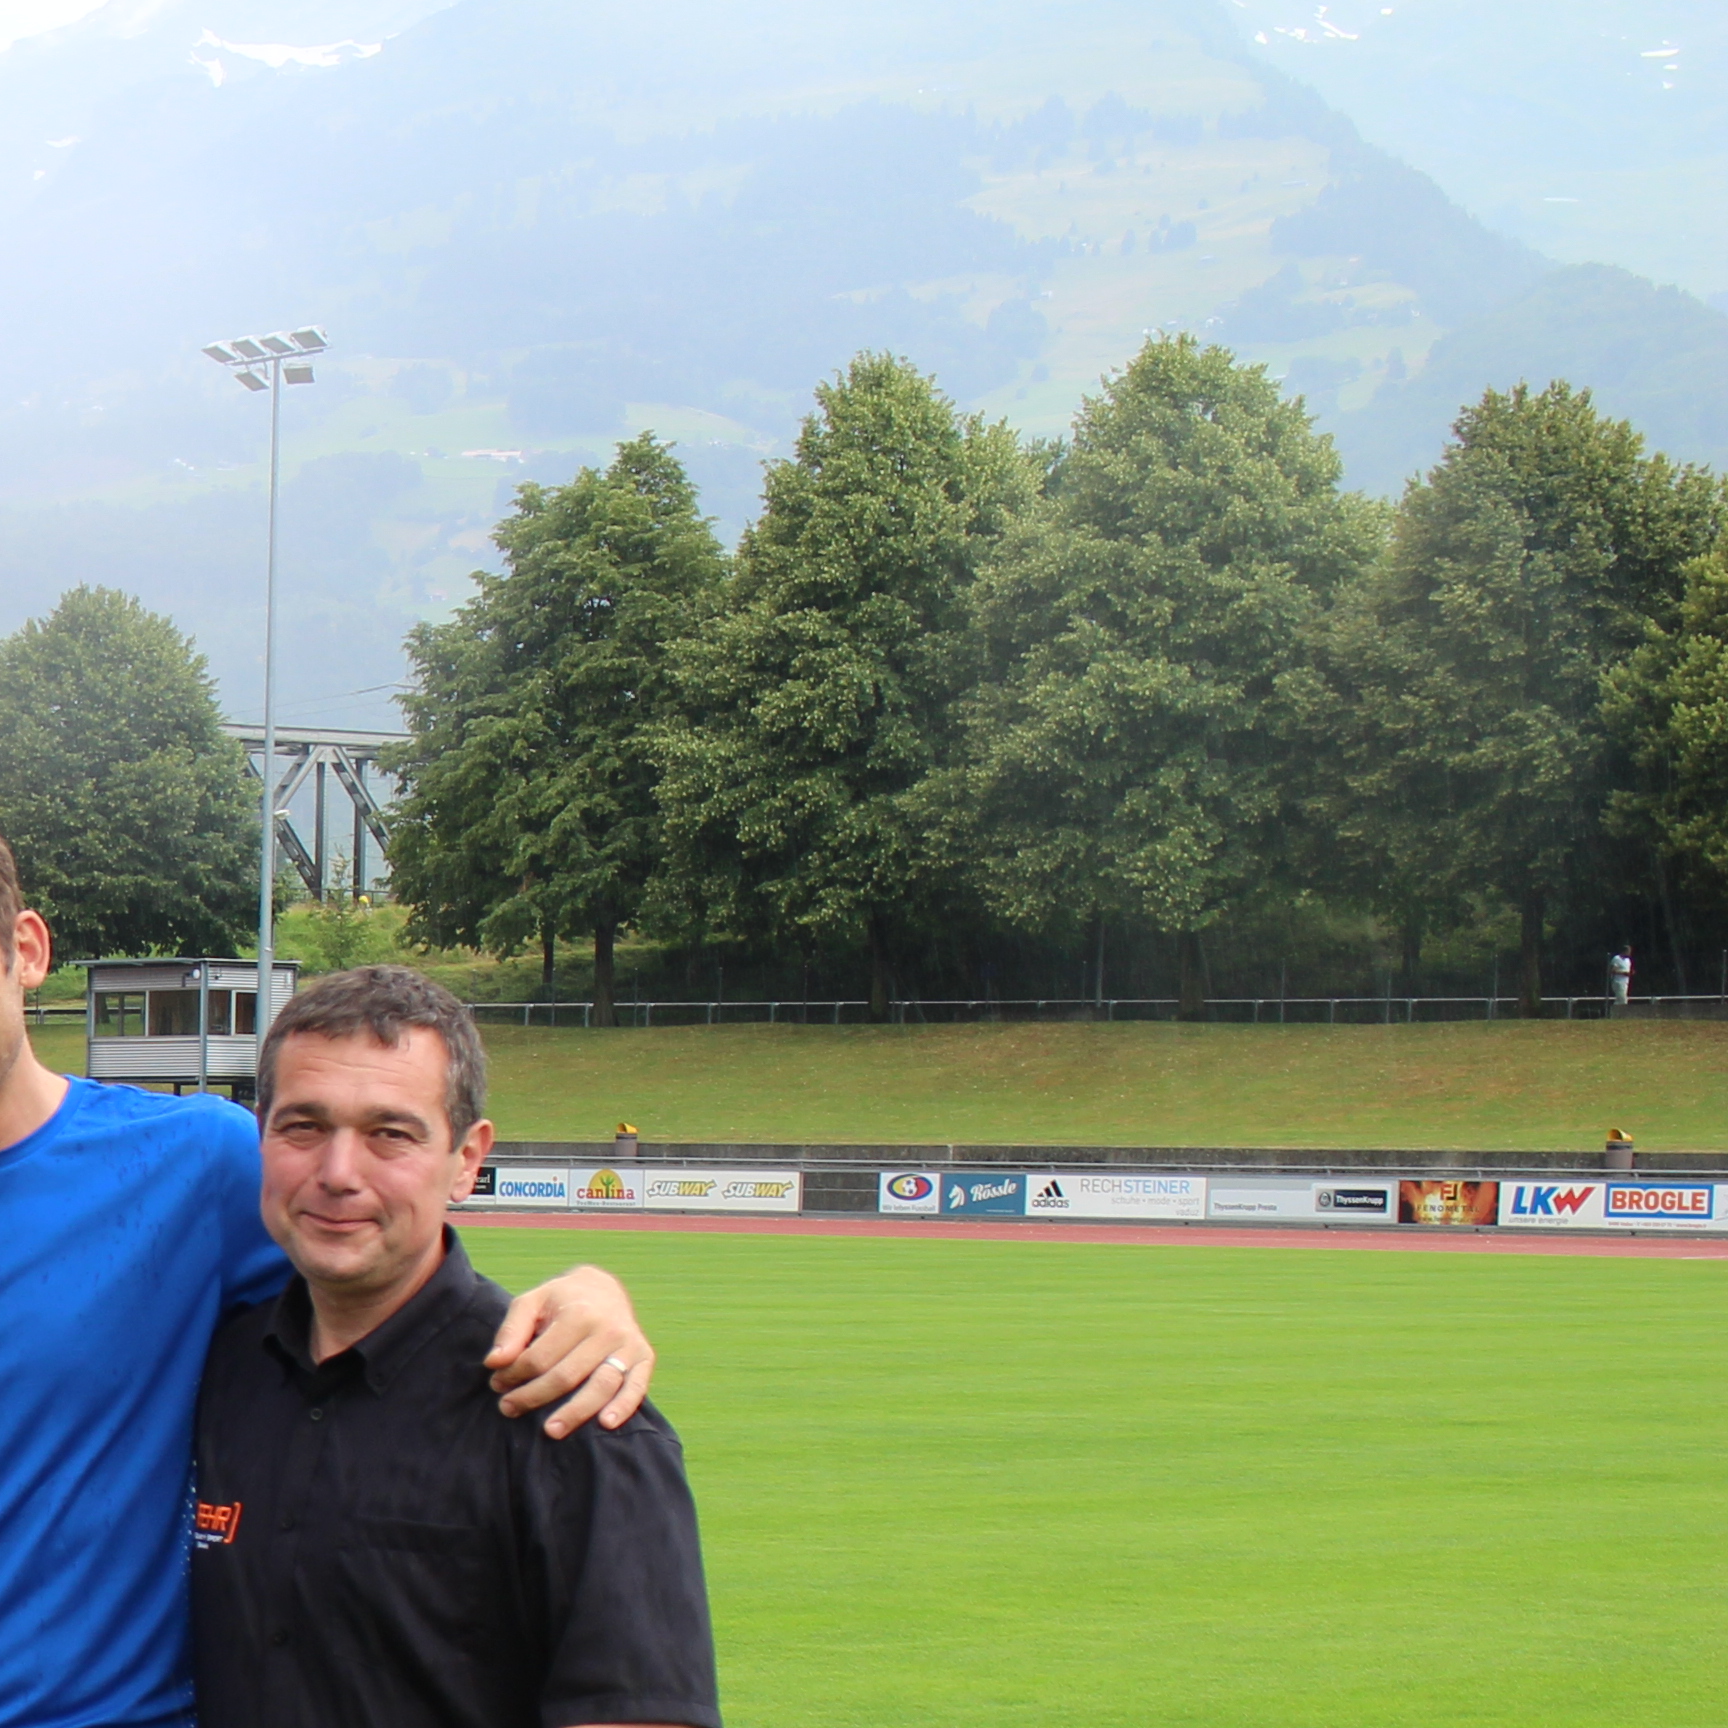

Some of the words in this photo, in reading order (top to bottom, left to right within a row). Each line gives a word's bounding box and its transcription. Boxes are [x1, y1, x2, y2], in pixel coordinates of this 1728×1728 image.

[646, 1179, 717, 1198] SUBWAY
[721, 1179, 795, 1199] SUBWAY
[1080, 1178, 1190, 1194] RECHSTEINER
[1031, 1197, 1070, 1209] adidas
[1510, 1186, 1597, 1215] LKW
[1611, 1189, 1706, 1212] BROGLE
